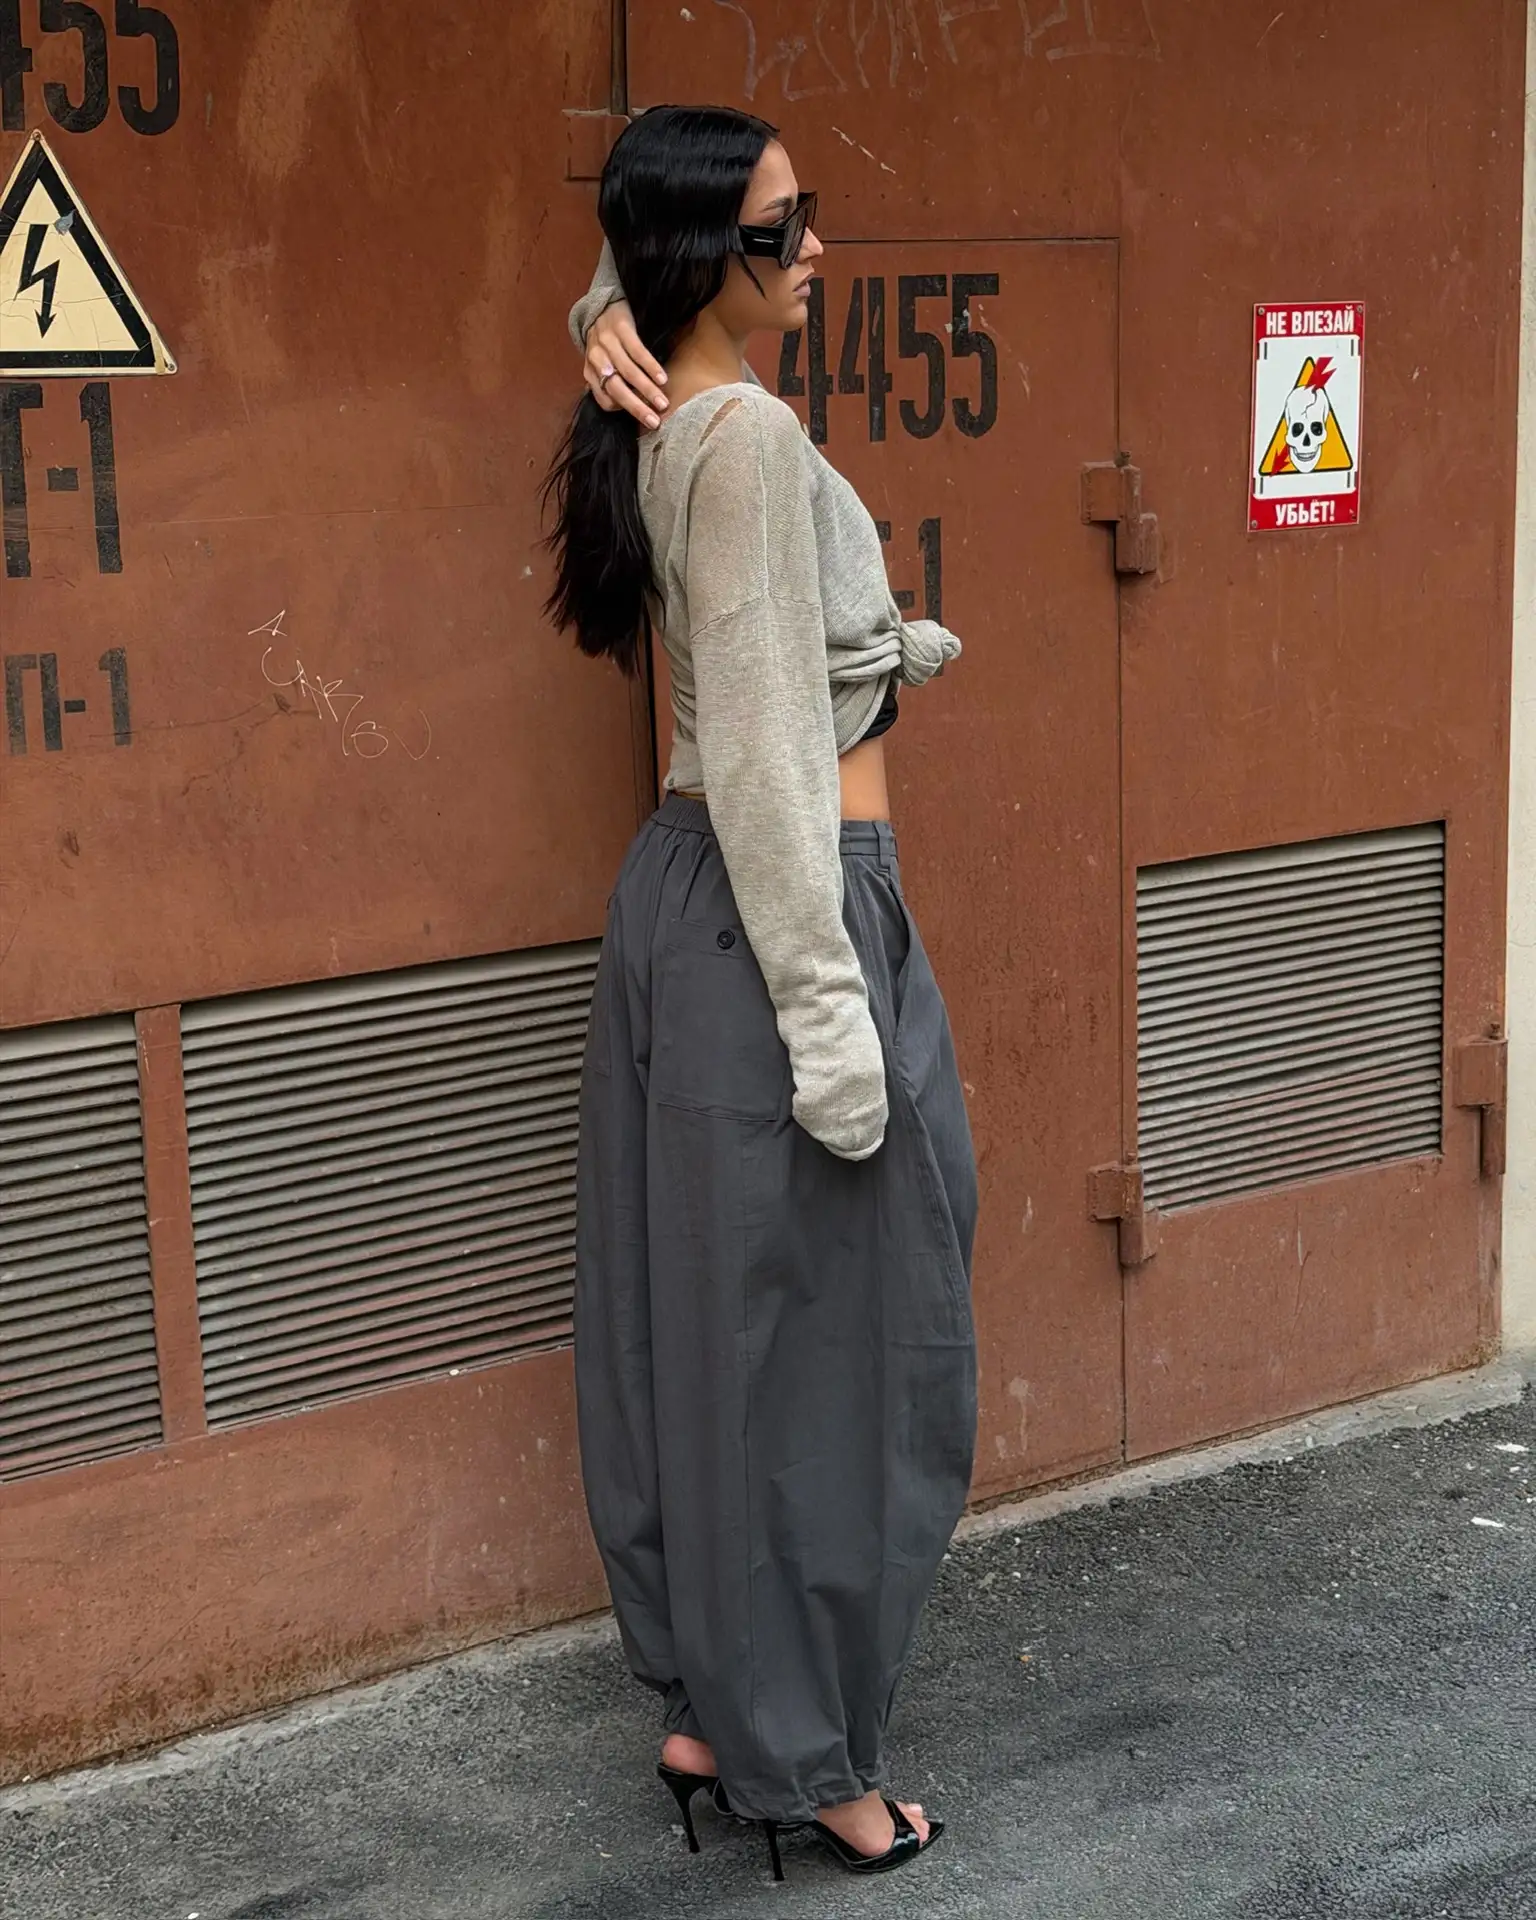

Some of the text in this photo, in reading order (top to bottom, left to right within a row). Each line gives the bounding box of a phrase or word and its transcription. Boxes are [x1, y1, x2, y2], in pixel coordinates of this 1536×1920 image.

[0, 0, 181, 136] 55
[777, 273, 999, 445] 4455
[1266, 305, 1354, 335] НЕ ВЛЕЗАЙ
[1275, 500, 1335, 526] УБЬЁТ!
[5, 647, 132, 755] П-1
